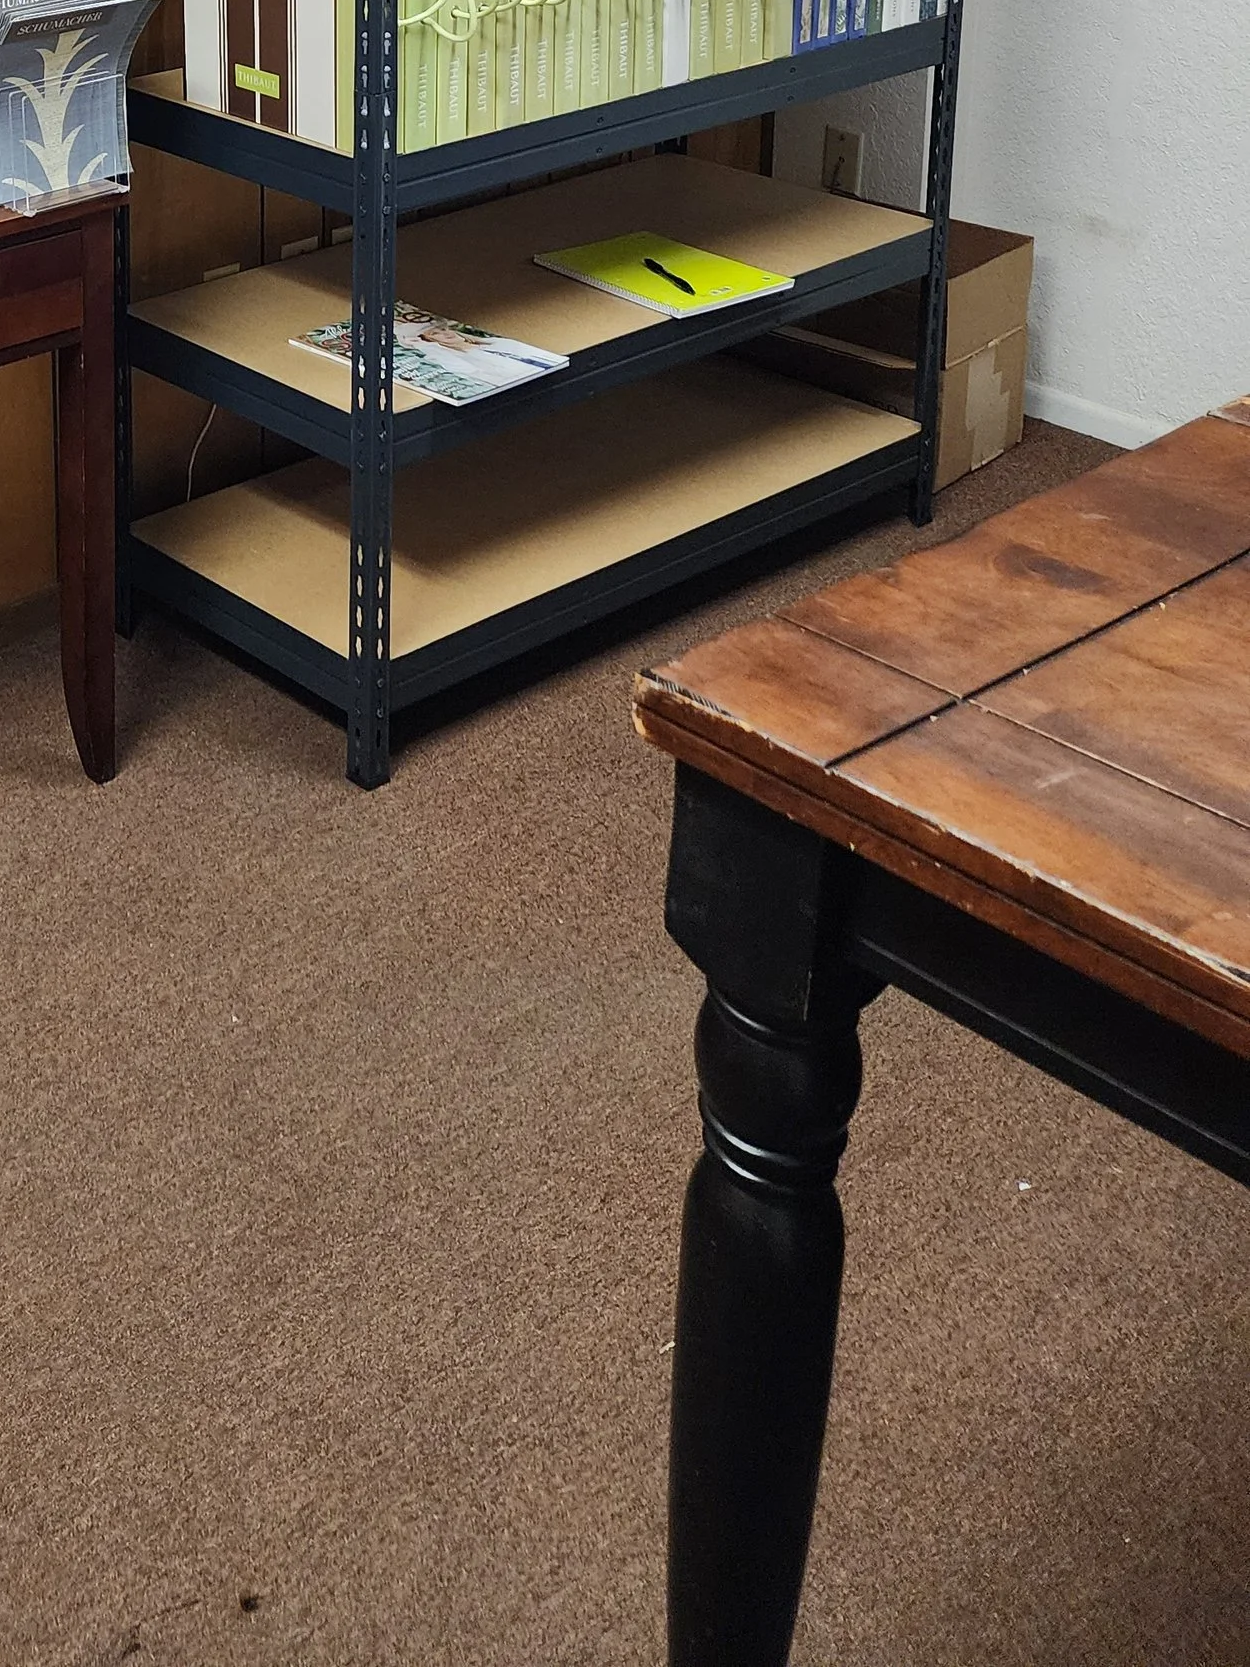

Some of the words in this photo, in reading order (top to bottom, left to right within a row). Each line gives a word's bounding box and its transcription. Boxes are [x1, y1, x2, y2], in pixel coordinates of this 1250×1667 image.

[16, 12, 104, 35] SCHUMACHER
[618, 19, 629, 78] THIBAUT
[646, 15, 654, 72] THIBAUT
[700, 1, 708, 58] THIBAUT
[237, 70, 277, 91] THIBAUT
[449, 58, 459, 120] THIBAUT
[478, 50, 487, 112] THIBAUT
[510, 44, 520, 105] THIBAUT
[537, 38, 548, 99] THIBAUT
[565, 30, 574, 91] THIBAUT
[418, 64, 427, 128] THIBAUT
